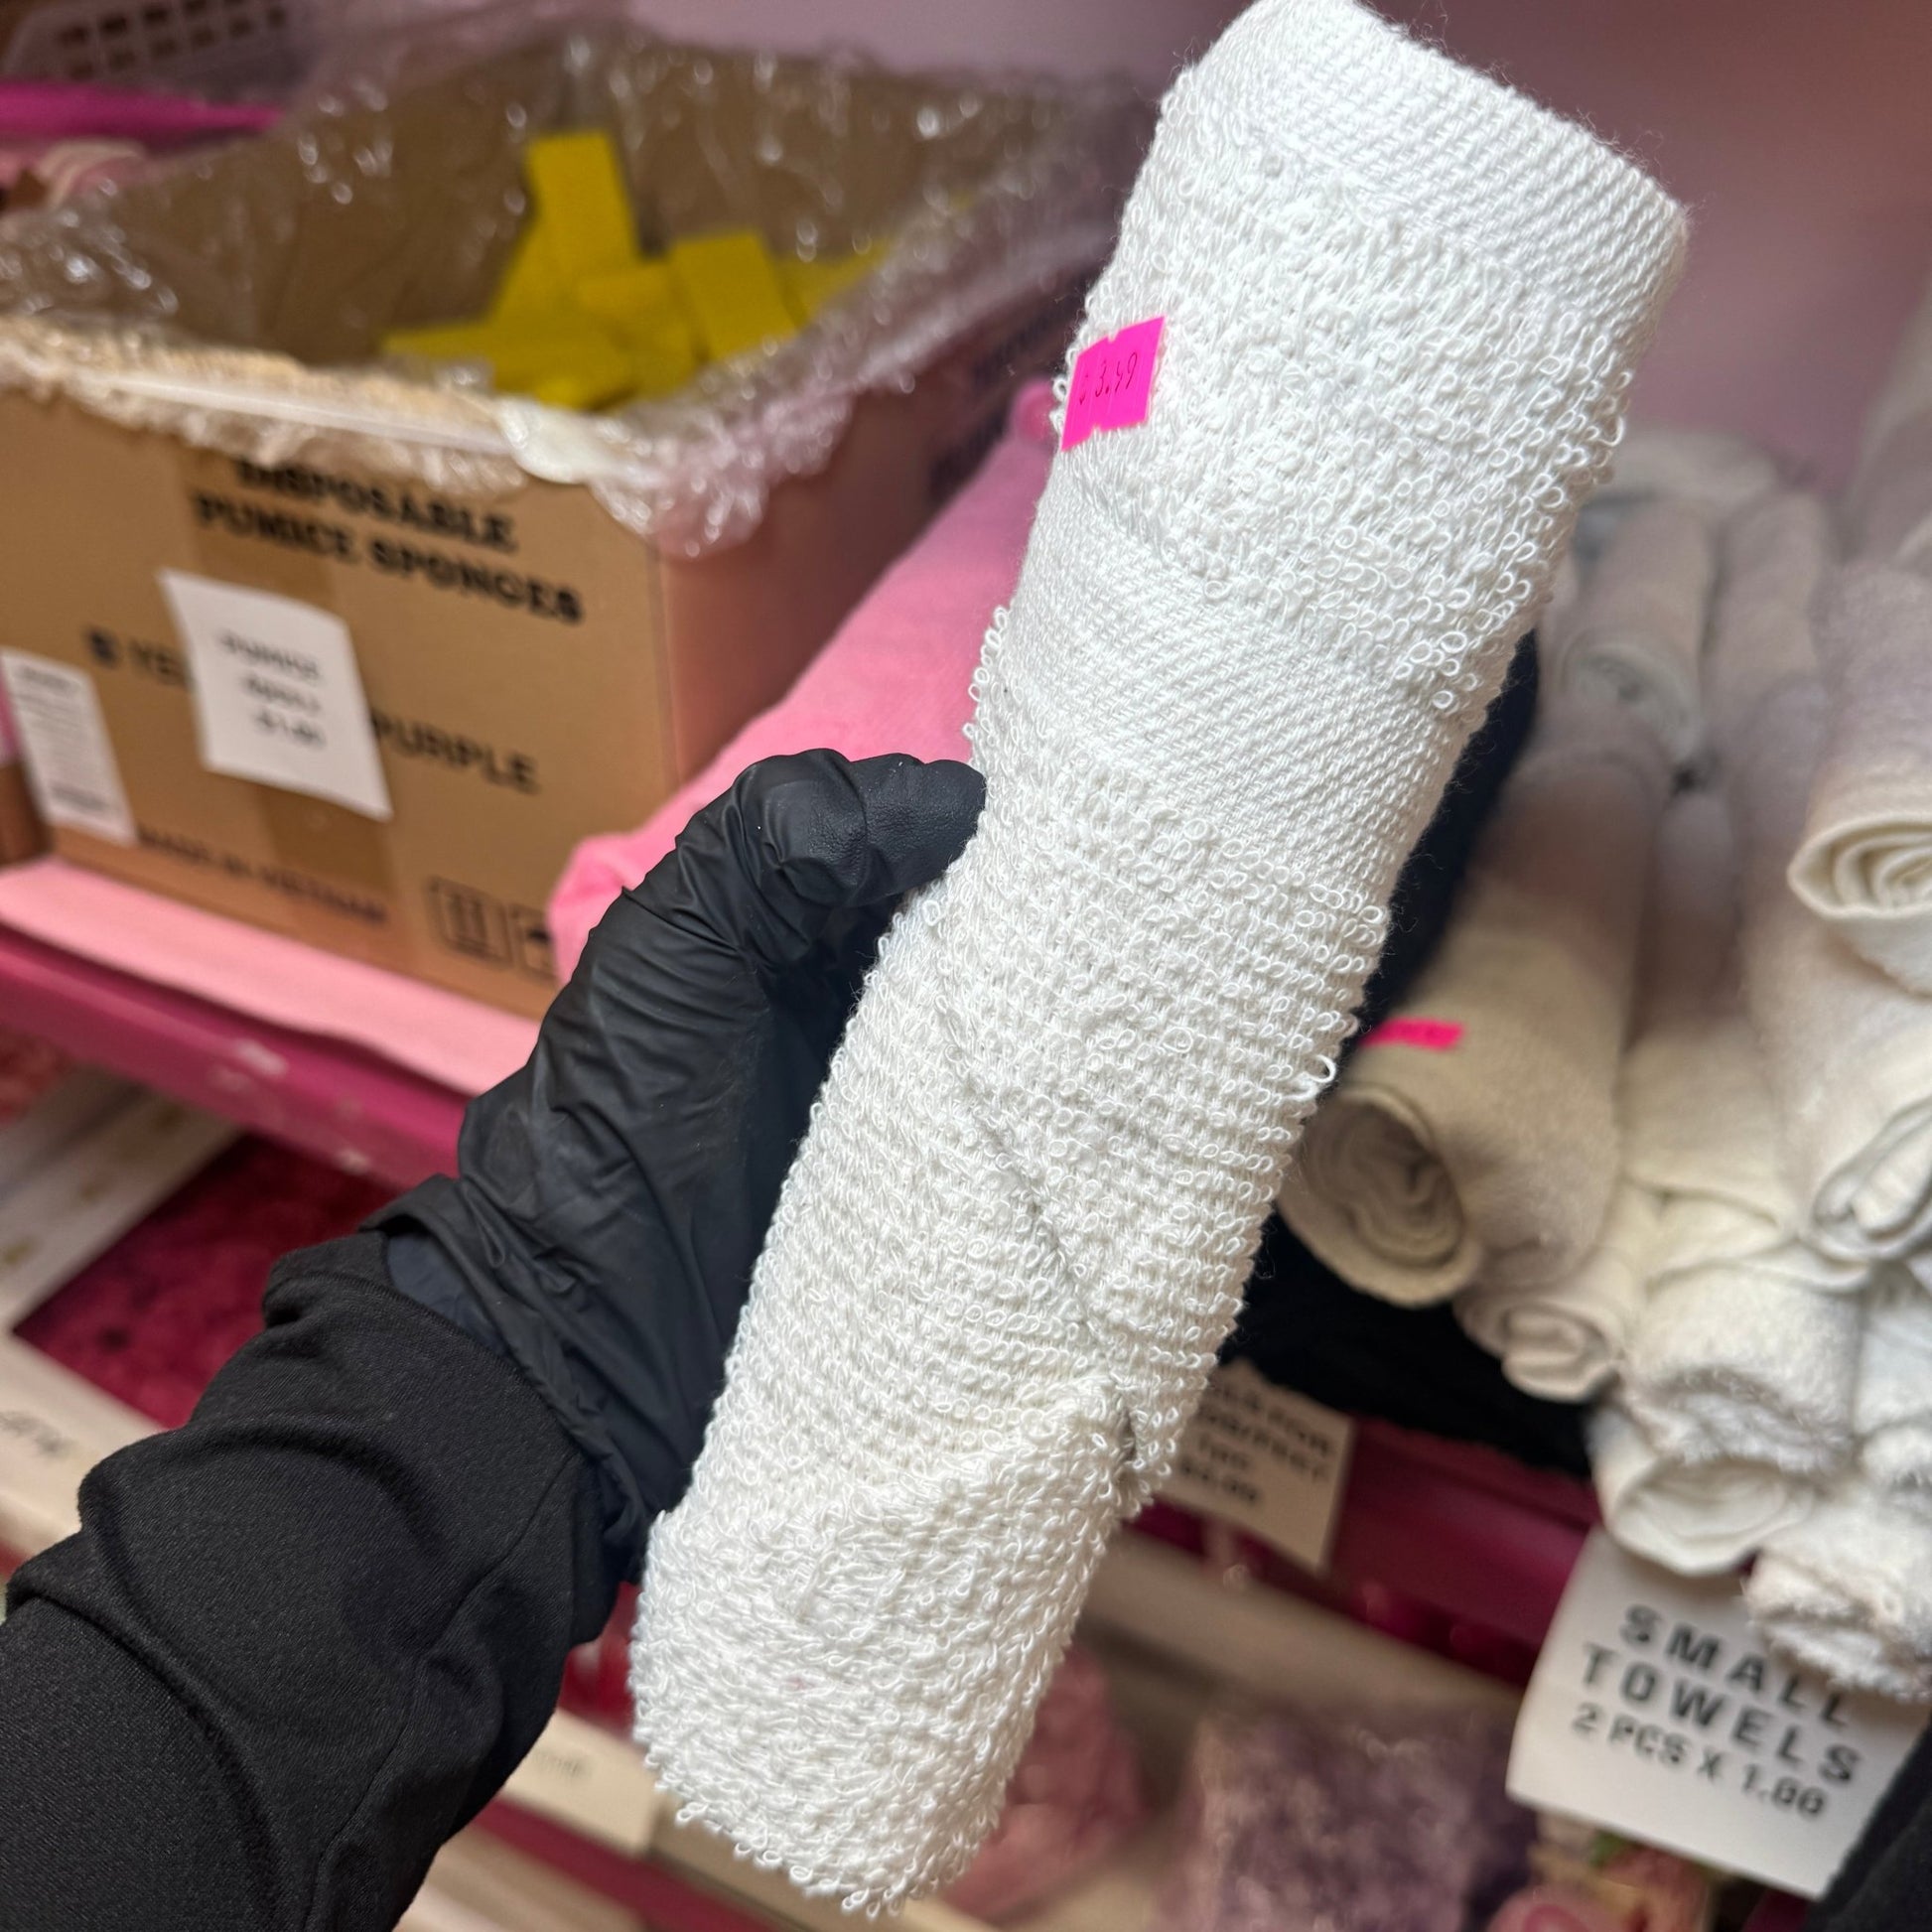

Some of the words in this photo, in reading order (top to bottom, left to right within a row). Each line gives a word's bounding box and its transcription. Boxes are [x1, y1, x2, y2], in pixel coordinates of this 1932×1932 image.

[197, 493, 358, 563] PUMICE
[370, 539, 584, 623] SPONGES
[1583, 1643, 1863, 1784] TOWELS
[1619, 1603, 1849, 1727] SMALL
[1572, 1702, 1599, 1733] 2
[1607, 1714, 1687, 1766] PCS
[1697, 1750, 1724, 1781] X
[1741, 1763, 1827, 1820] 1.00
